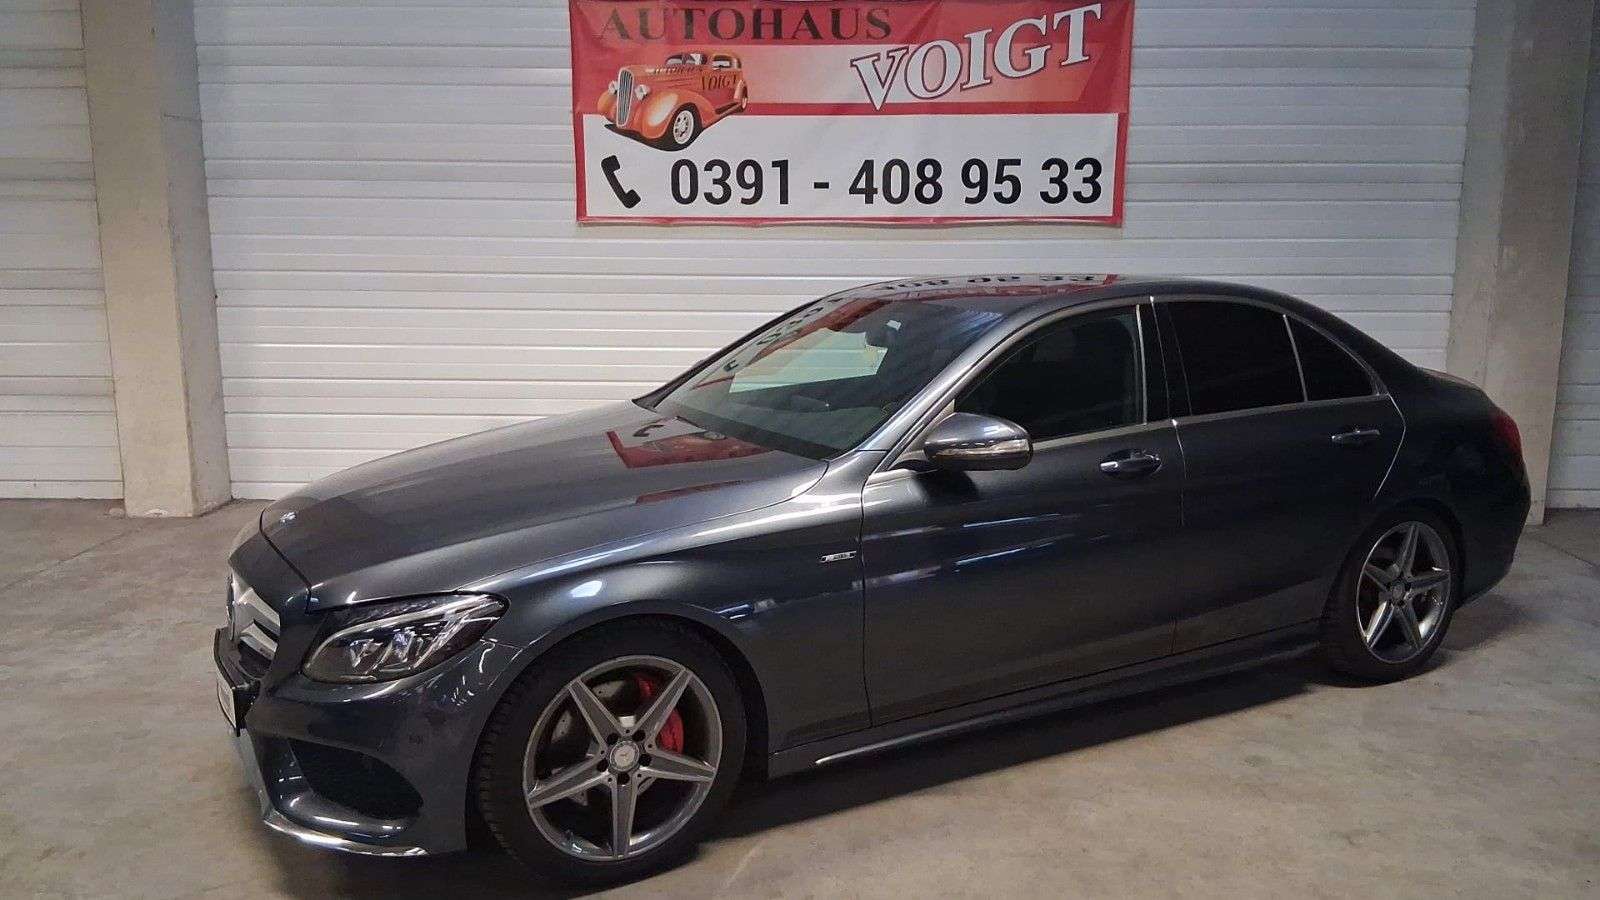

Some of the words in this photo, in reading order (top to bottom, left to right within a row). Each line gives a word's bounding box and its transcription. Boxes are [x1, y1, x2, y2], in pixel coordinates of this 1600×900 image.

[600, 7, 891, 41] AUTOHAUS
[851, 4, 1102, 110] VOIGT
[670, 159, 790, 204] 0391
[848, 159, 942, 204] 408
[961, 158, 1022, 204] 95
[1040, 157, 1103, 204] 33
